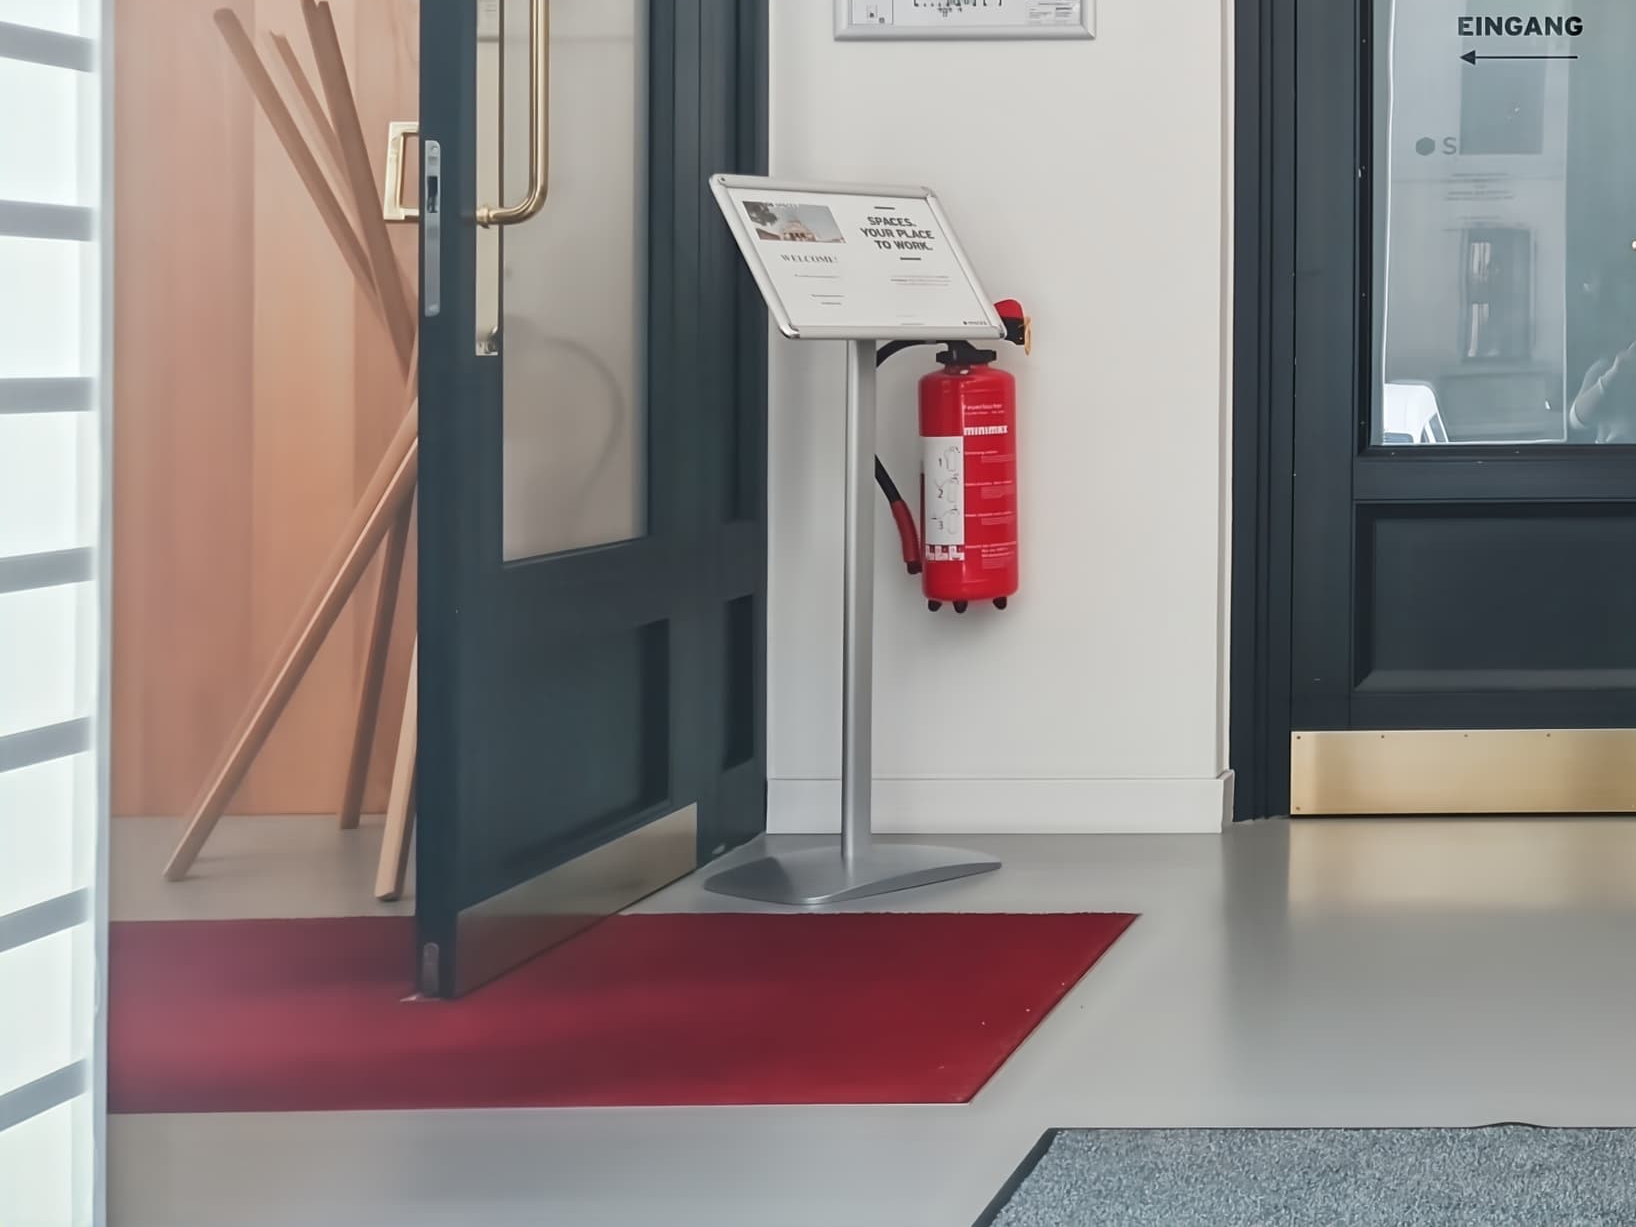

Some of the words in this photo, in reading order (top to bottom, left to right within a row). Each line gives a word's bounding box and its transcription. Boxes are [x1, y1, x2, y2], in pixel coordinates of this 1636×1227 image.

[1457, 16, 1584, 38] EINGANG
[867, 216, 918, 227] SPACES.
[859, 227, 896, 238] YOUR
[895, 229, 935, 240] PLACE
[874, 239, 892, 250] TO
[893, 240, 934, 251] WORK.
